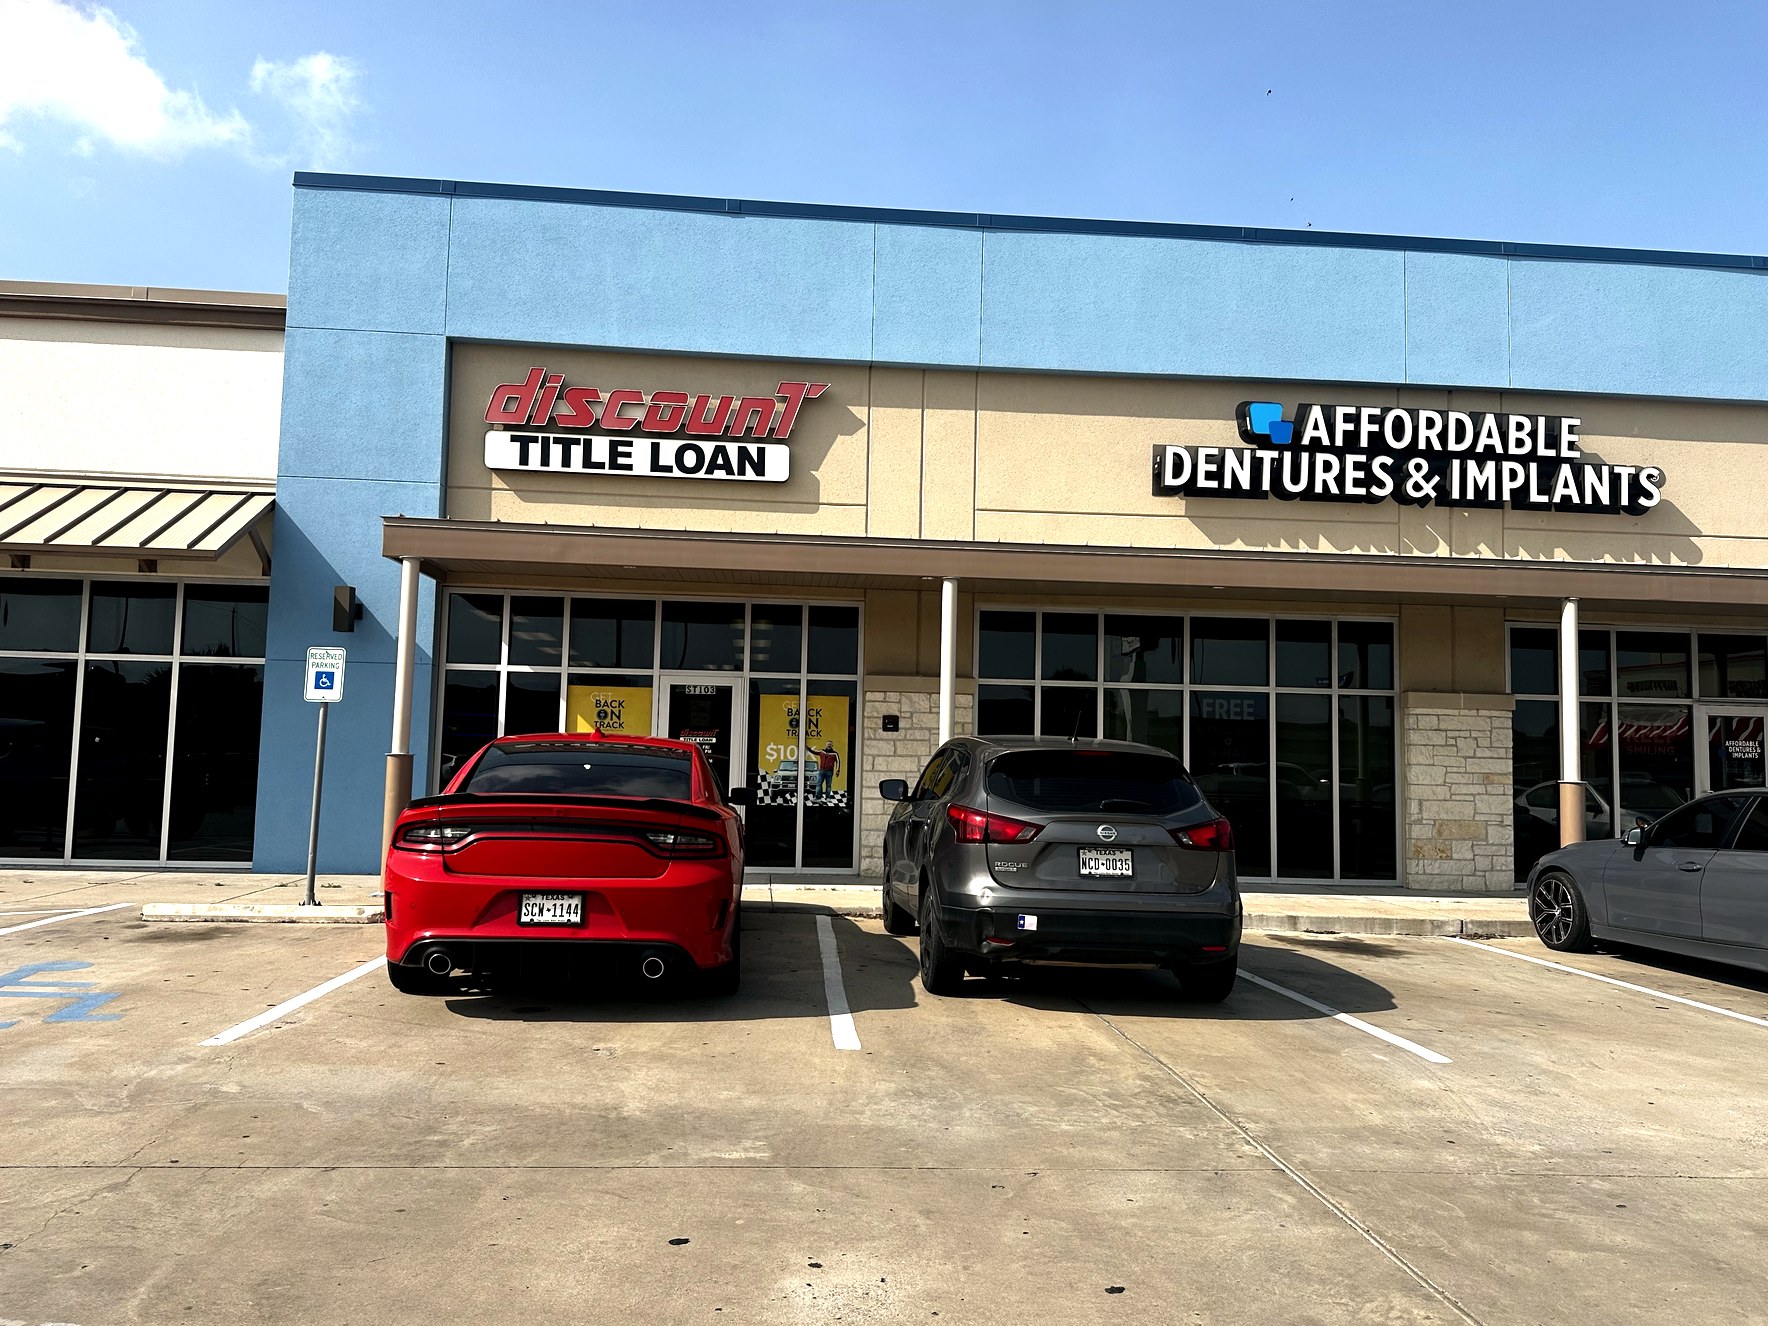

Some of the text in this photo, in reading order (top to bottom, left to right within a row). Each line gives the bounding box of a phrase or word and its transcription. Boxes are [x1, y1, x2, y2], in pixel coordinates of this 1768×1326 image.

[1300, 404, 1582, 459] AFFORDABLE
[510, 434, 766, 477] TITLE LOAN
[1163, 445, 1663, 508] DENTURES & IMPLANTS
[686, 685, 716, 694] ST103
[590, 692, 614, 702] GET
[595, 699, 625, 709] BACK
[1202, 698, 1255, 720] FREE
[596, 709, 622, 721] ON
[594, 720, 625, 729] TRACK
[1626, 745, 1675, 756] SMILING
